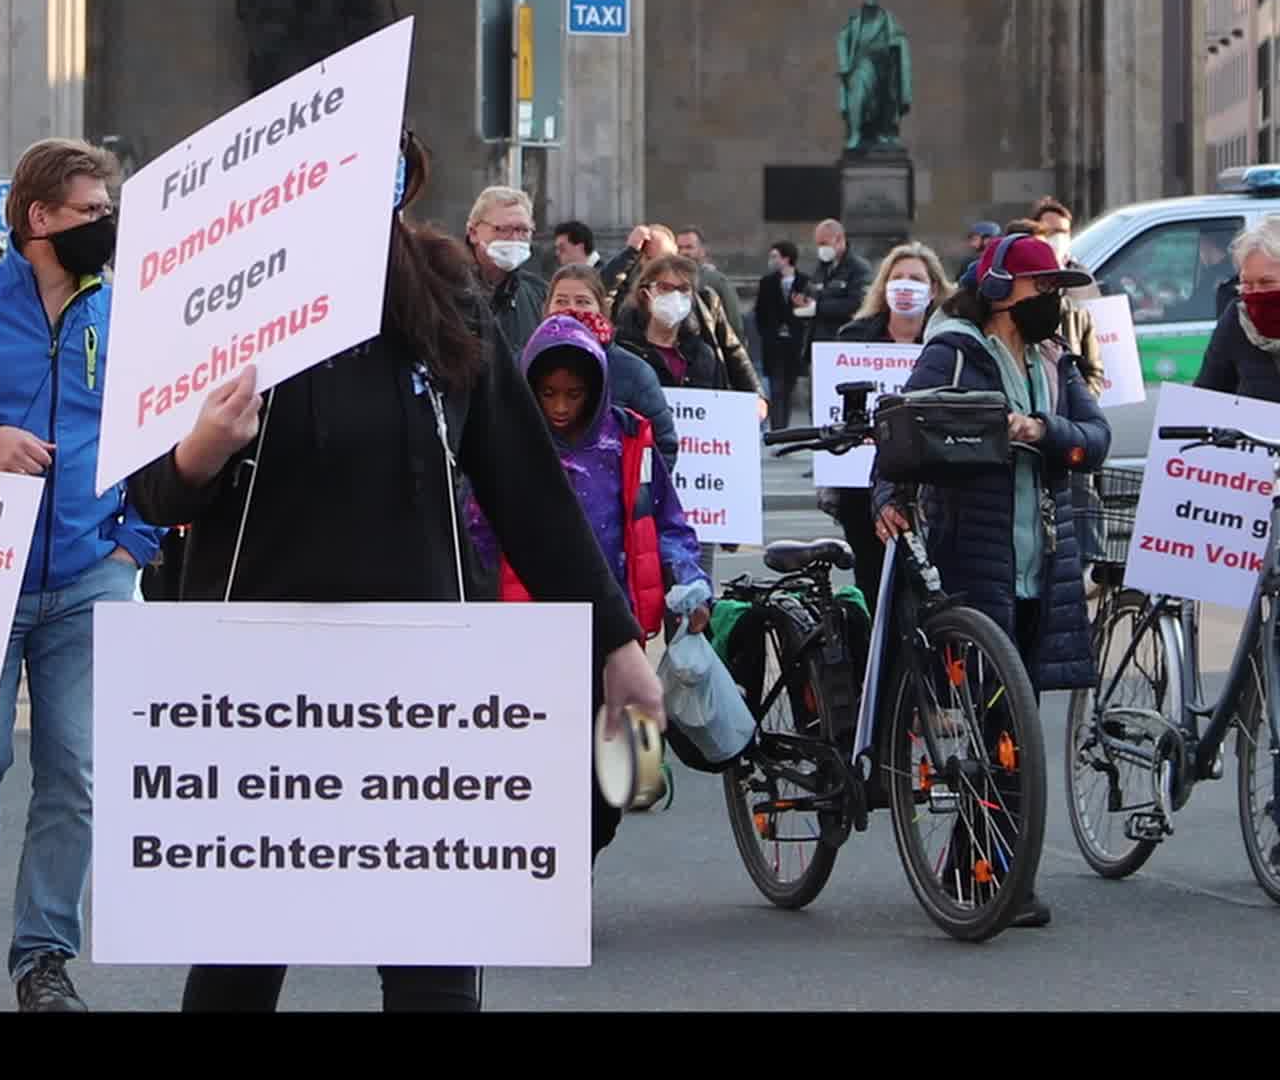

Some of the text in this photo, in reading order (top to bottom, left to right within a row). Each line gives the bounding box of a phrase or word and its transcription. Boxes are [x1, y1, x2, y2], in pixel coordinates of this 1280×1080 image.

[574, 4, 622, 27] TAXI
[162, 86, 346, 211] Für direkte
[139, 158, 330, 291] Demokratie
[184, 246, 287, 326] Gegen
[137, 293, 330, 427] Faschismus
[694, 473, 725, 491] die
[1176, 500, 1243, 529] drum
[1140, 535, 1195, 559] zum
[132, 694, 548, 729] -reitschuster.de-
[132, 765, 533, 801] Mal eine andere
[132, 836, 558, 880] Berichterstattung
